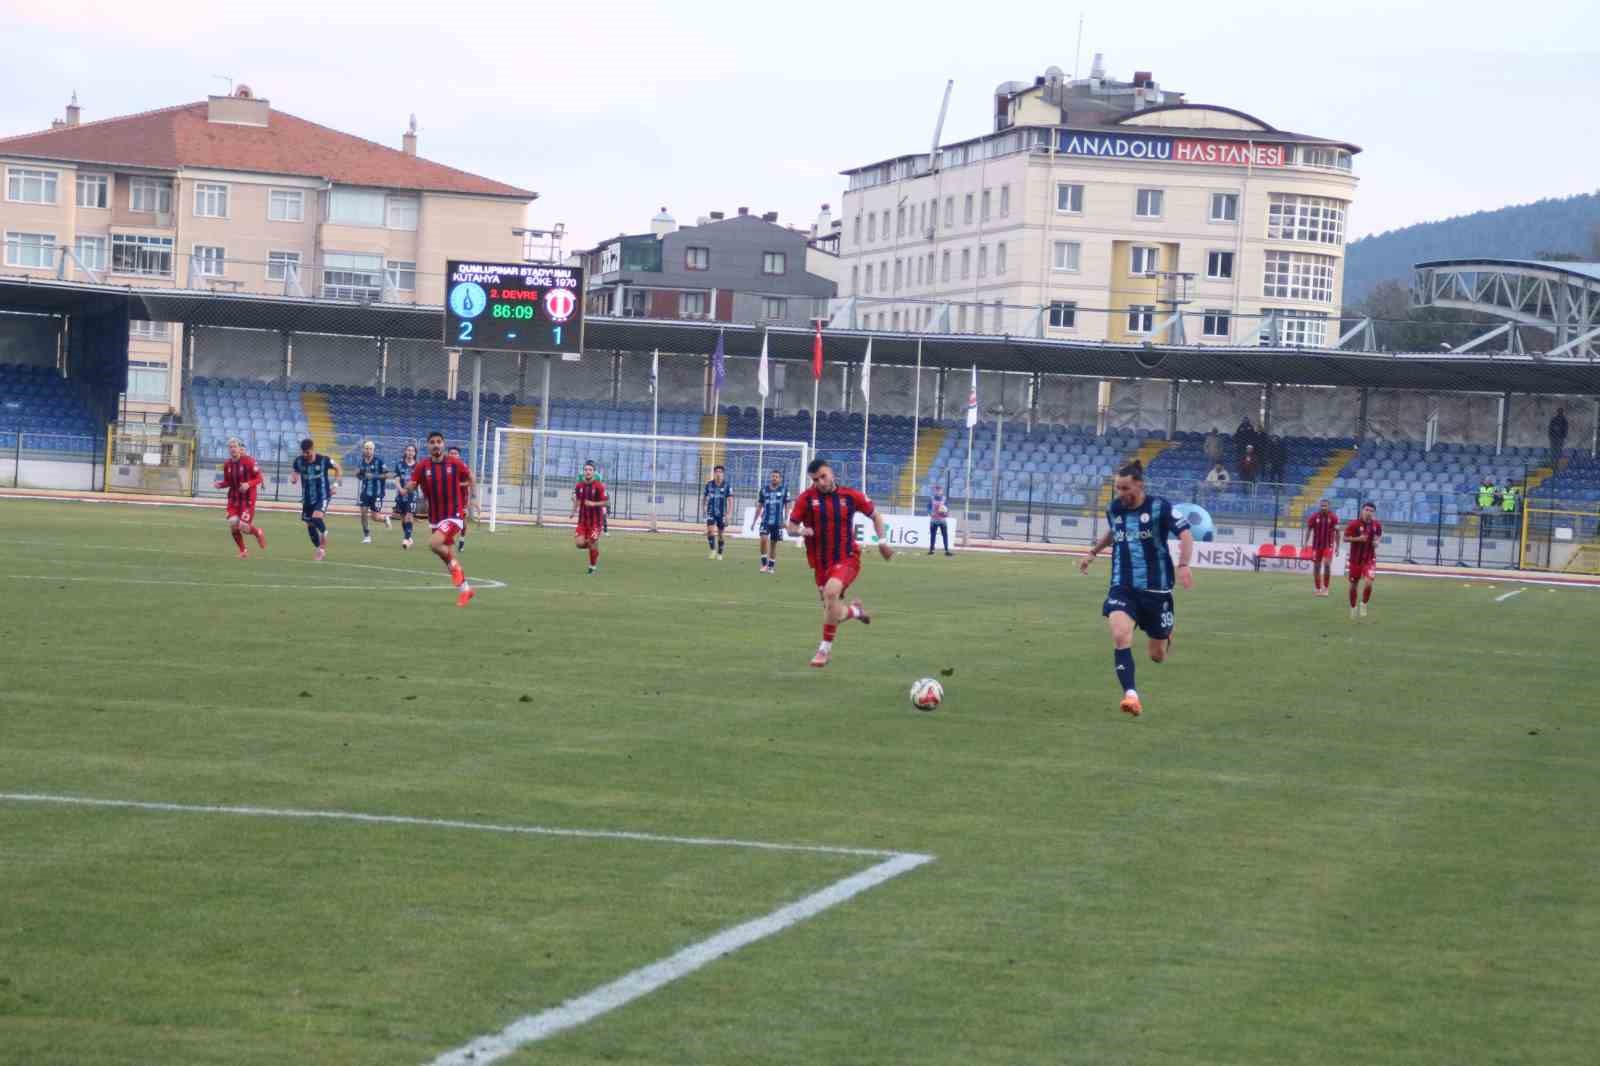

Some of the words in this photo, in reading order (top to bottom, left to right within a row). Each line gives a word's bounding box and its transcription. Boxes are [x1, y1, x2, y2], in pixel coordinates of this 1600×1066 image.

[1067, 135, 1170, 160] ANADOLU
[458, 264, 519, 276] DUMLUPINAR
[555, 278, 577, 288] 1970
[489, 289, 500, 299] 2.
[501, 290, 538, 301] DEVRE
[492, 304, 534, 319] 86:09
[458, 321, 473, 341] 2
[552, 326, 562, 345] 1
